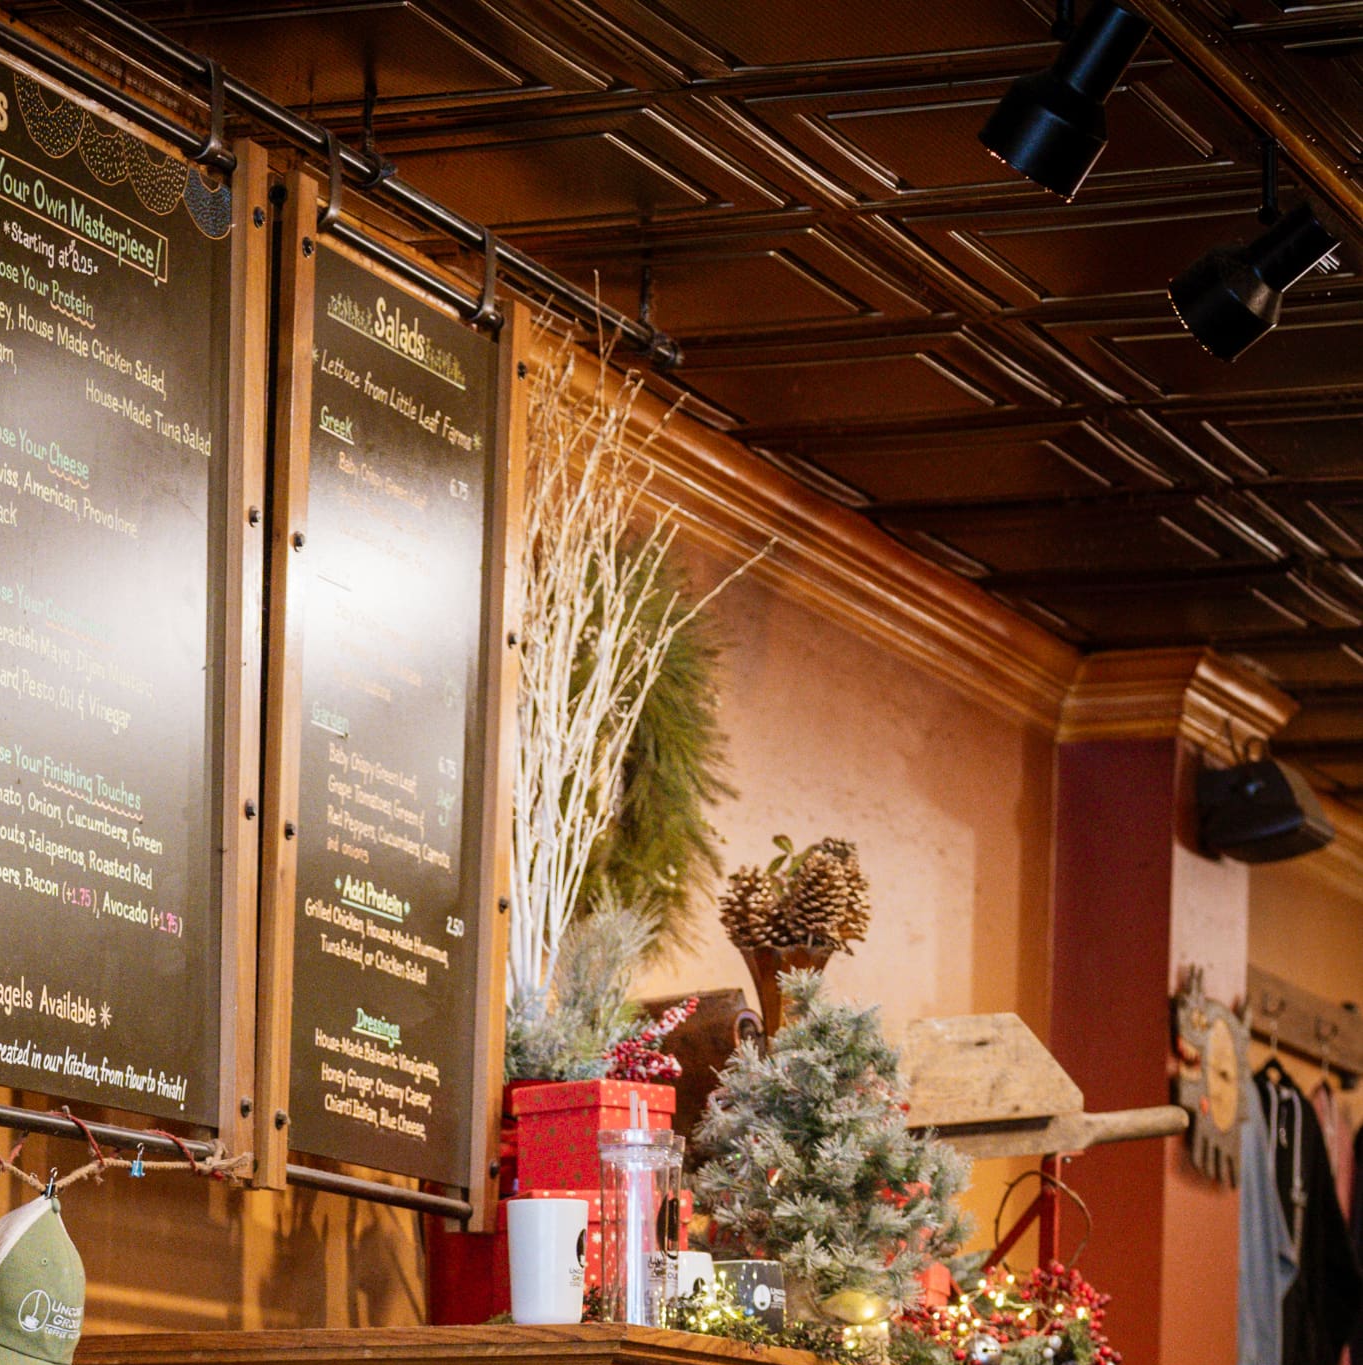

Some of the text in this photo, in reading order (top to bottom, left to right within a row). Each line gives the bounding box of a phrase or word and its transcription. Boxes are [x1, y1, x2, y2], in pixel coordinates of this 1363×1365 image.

[34, 180, 67, 223] Own
[72, 197, 162, 287] Masterpiece!
[58, 247, 68, 268] at
[22, 265, 48, 296] Your
[52, 280, 94, 320] Protein
[374, 297, 425, 361] Salads
[86, 378, 211, 456] House-Made Tuna Salad
[320, 406, 354, 440] Greek
[321, 349, 473, 451] Lettuce from Little Leaf Farms
[343, 874, 403, 916] Add Protein
[39, 984, 96, 1027] Available
[356, 1007, 400, 1048] Dressings
[31, 1045, 42, 1069] in
[43, 1054, 63, 1074] our
[100, 1056, 123, 1088] from
[125, 1064, 147, 1090] flour
[157, 1071, 187, 1111] finish!
